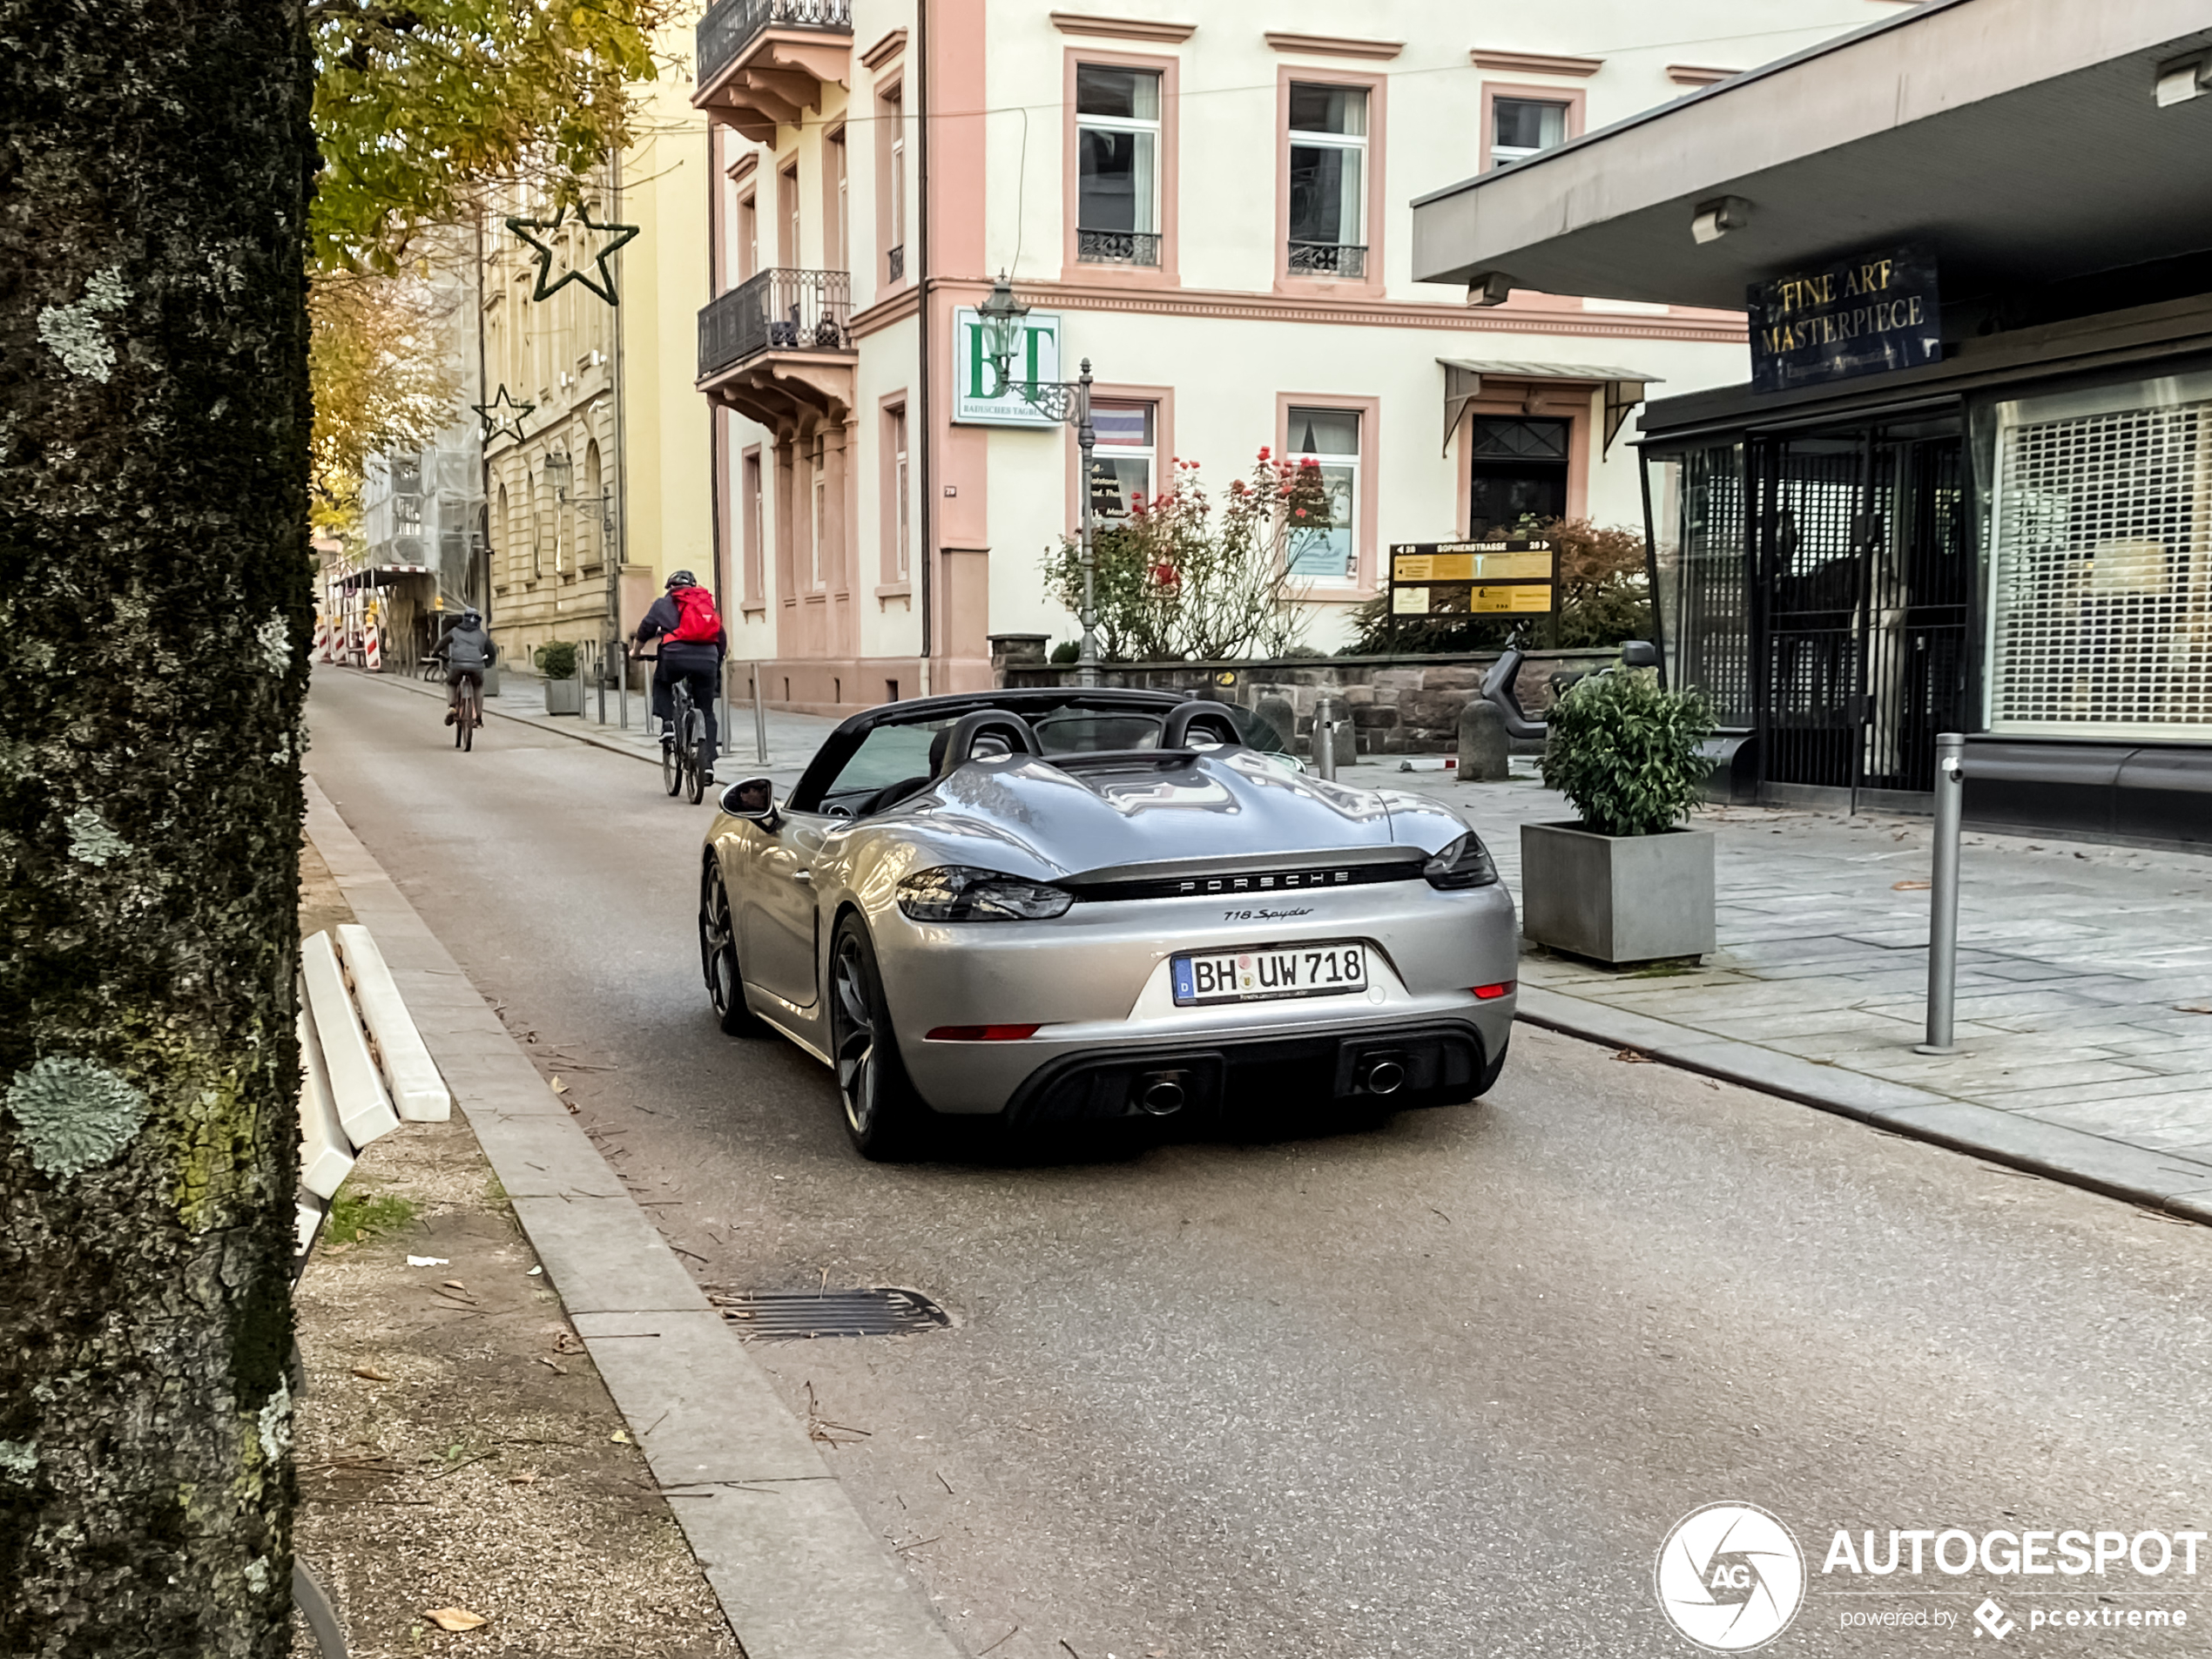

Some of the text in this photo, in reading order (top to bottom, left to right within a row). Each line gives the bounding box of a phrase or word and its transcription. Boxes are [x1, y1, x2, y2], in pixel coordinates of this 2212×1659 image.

[1779, 260, 1892, 313] FINE ART
[1762, 295, 1925, 356] MASTERPIECE
[964, 323, 1055, 401] BT
[963, 405, 1011, 415] BADISCHES
[1437, 543, 1507, 553] SOPHIENSTRASSE
[1180, 872, 1350, 893] PORSCHE
[1224, 907, 1315, 921] 718 Spyder
[1180, 950, 1361, 993] D BH UW 718
